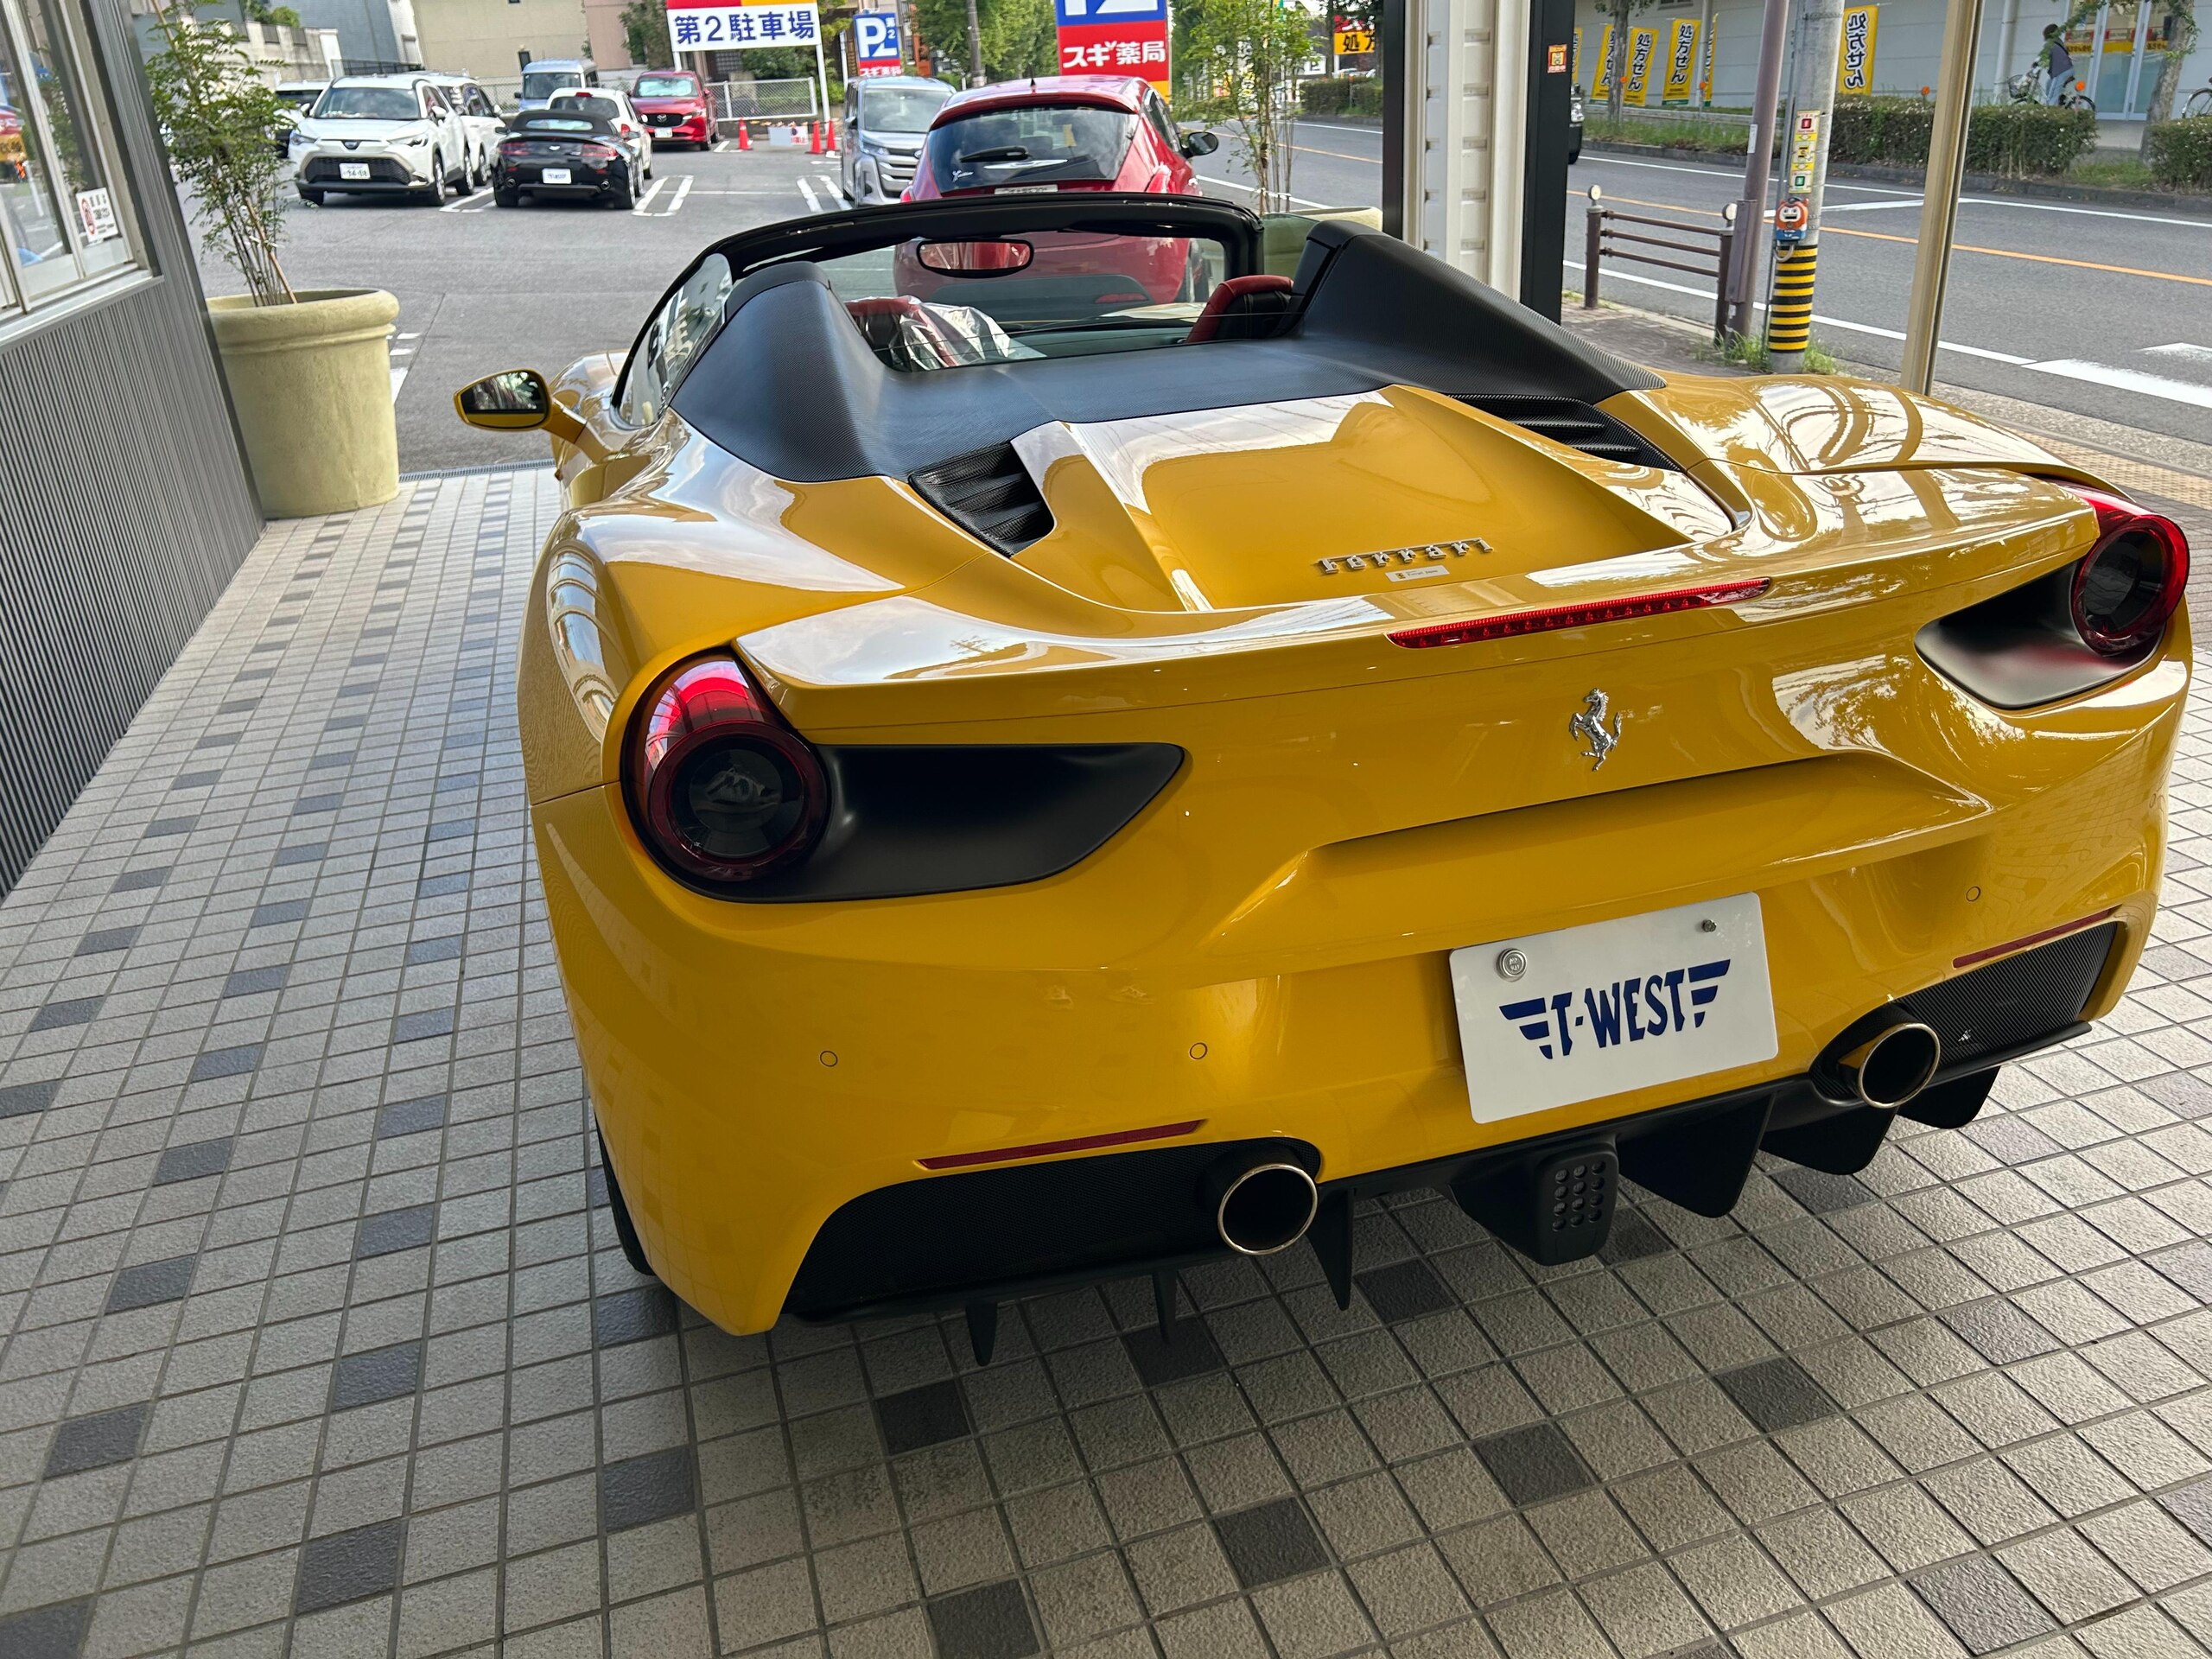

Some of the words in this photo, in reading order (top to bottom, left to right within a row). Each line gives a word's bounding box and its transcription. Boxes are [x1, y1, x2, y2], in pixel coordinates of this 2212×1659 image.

[674, 10, 815, 44] 第2駐車場
[1063, 41, 1166, 68] スギ薬局
[1669, 22, 1694, 85] 処方せん
[1627, 31, 1652, 92] 処方せん
[1551, 968, 1686, 1056] T-WEST
